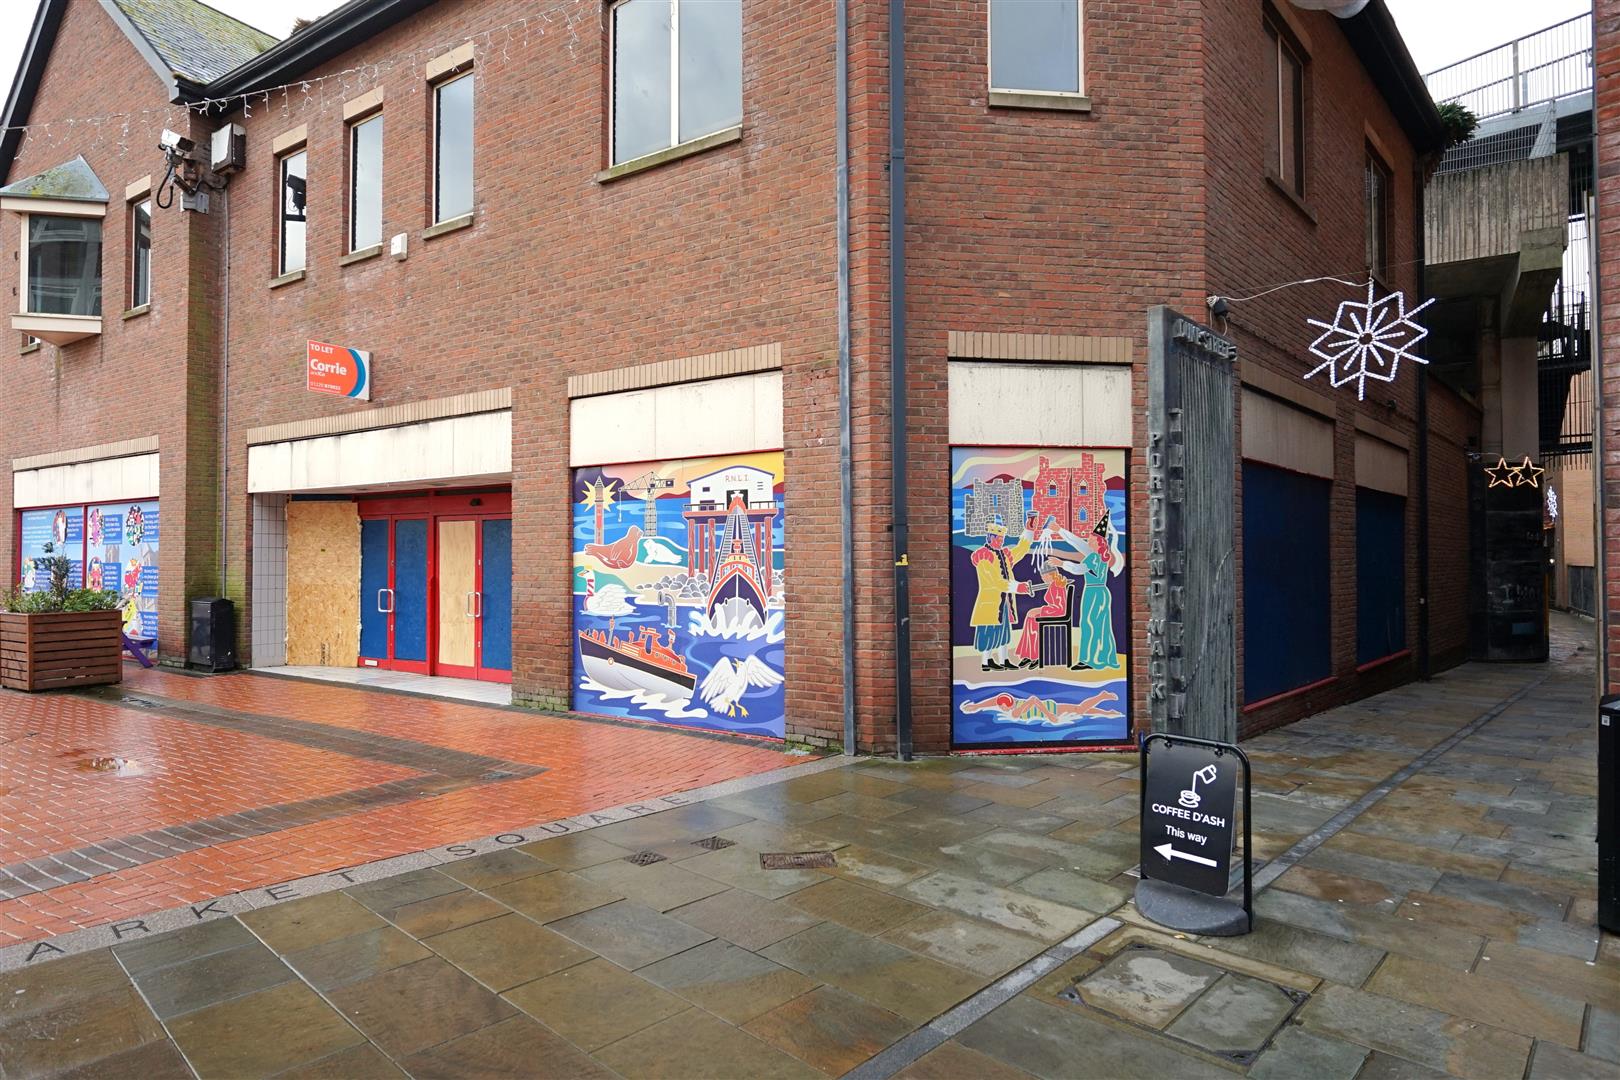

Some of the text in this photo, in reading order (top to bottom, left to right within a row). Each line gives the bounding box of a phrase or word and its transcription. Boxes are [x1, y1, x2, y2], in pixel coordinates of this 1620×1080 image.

[310, 343, 333, 354] TO LET
[310, 358, 347, 375] Corrie
[446, 795, 691, 857] SQUARE
[1152, 803, 1225, 828] COFFEE D'ASH
[1165, 825, 1207, 846] This way
